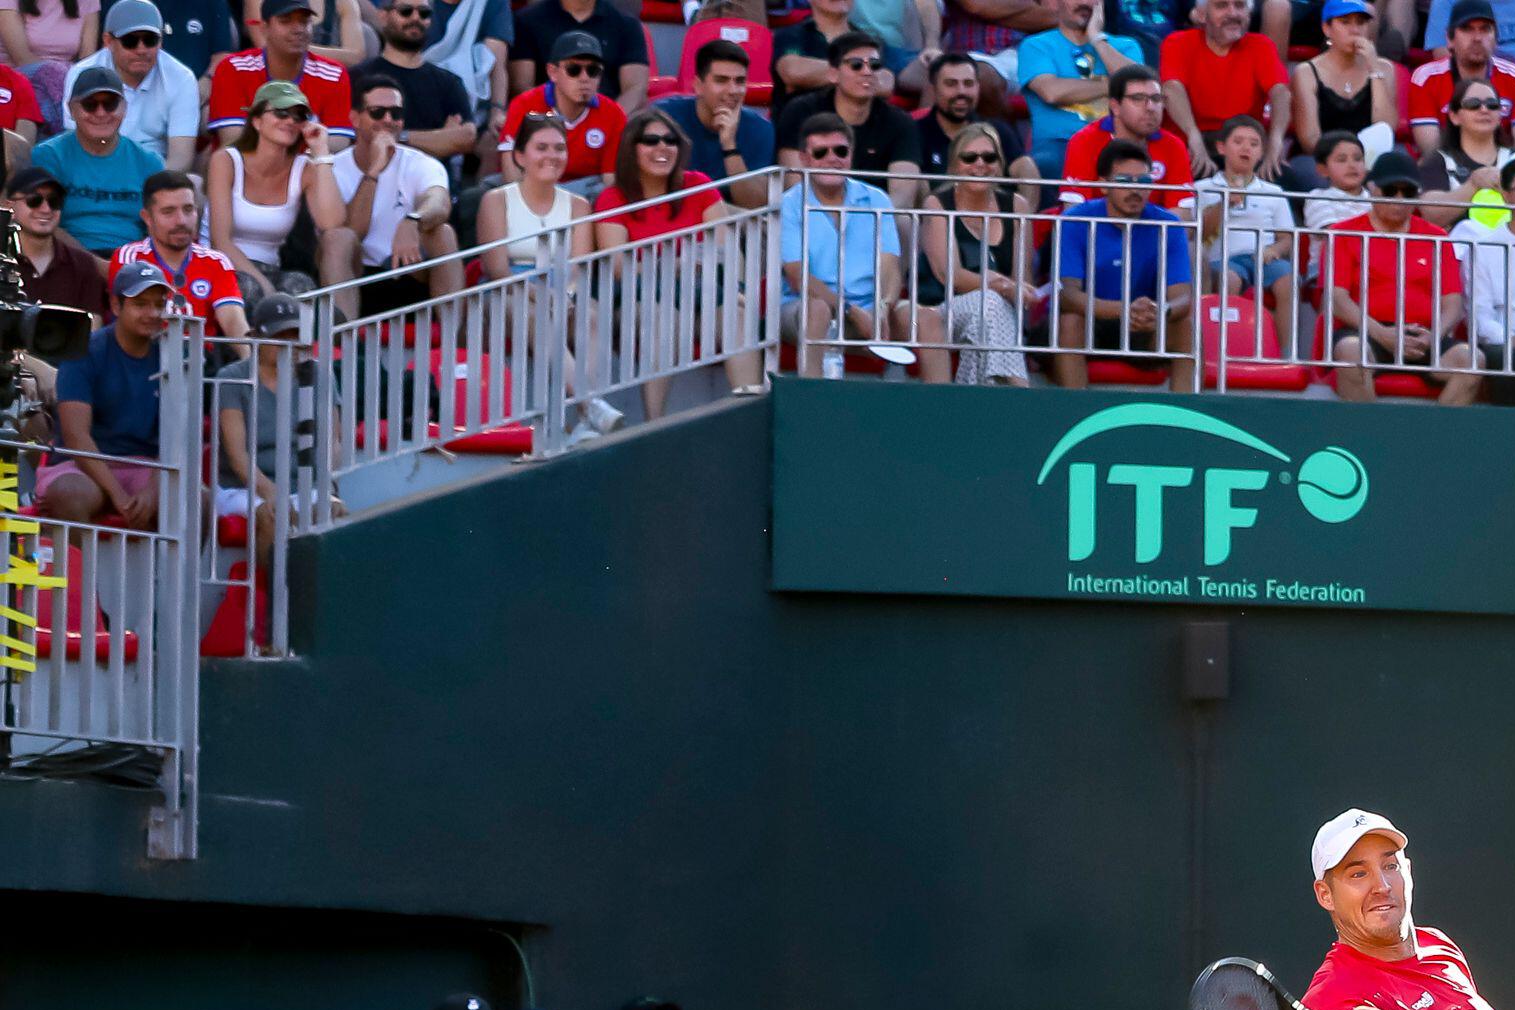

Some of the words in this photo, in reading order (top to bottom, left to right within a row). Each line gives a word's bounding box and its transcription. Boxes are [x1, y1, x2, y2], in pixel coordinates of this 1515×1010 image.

[1068, 463, 1269, 565] ITF
[1068, 573, 1188, 595] International
[1198, 576, 1257, 598] Tennis
[1266, 580, 1366, 603] Federation
